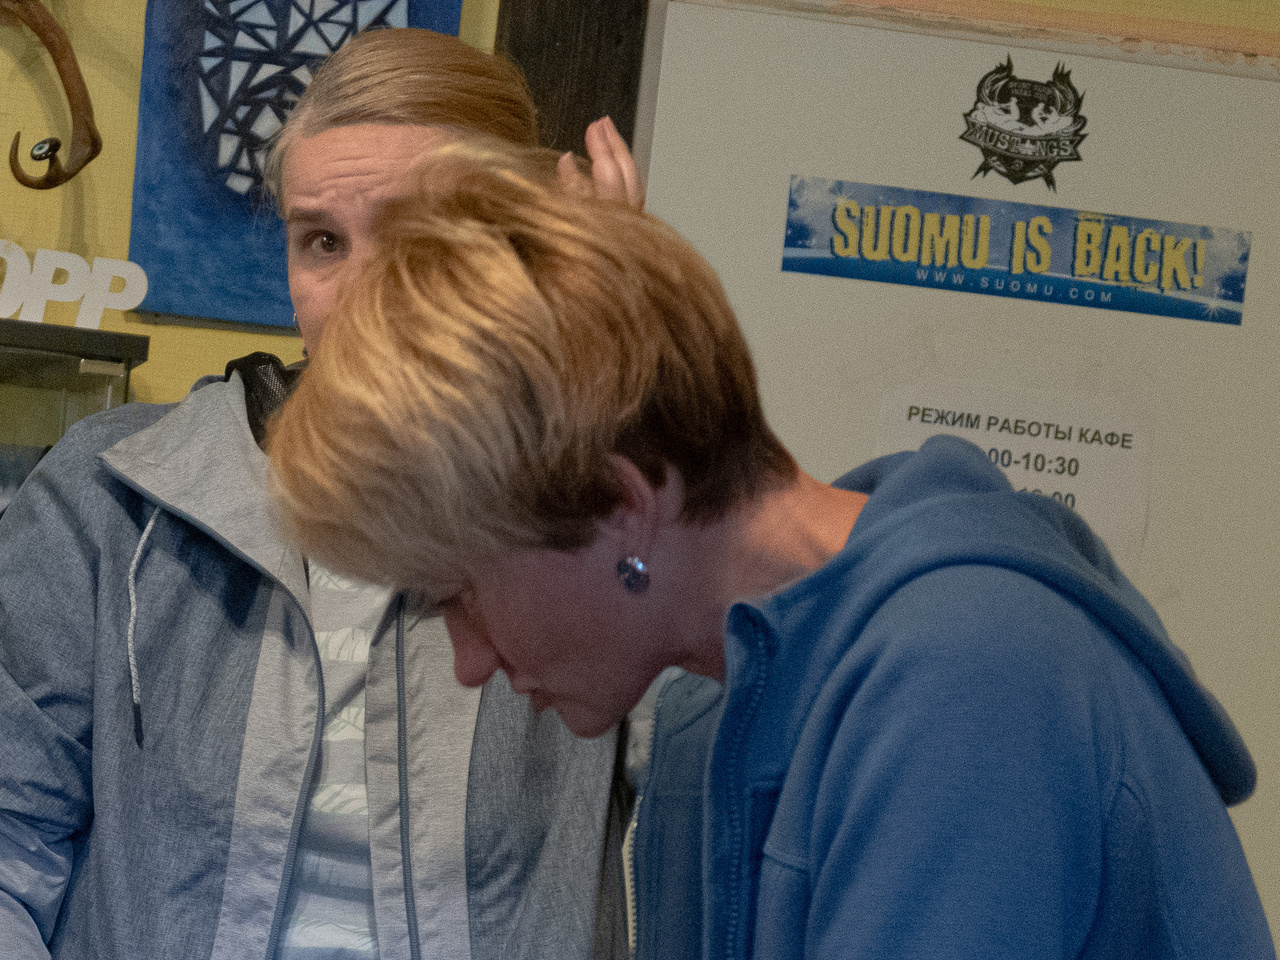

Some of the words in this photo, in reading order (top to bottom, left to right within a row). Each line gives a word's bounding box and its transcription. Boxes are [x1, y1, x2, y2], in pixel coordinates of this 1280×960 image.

[831, 199, 991, 270] SUOMU
[1010, 215, 1053, 275] IS
[1073, 212, 1207, 291] BACK!
[907, 405, 980, 430] РЕЖИМ
[986, 415, 1073, 442] РАБОТЫ
[1078, 427, 1134, 450] КАФЕ
[988, 448, 1080, 476] 00-10:30
